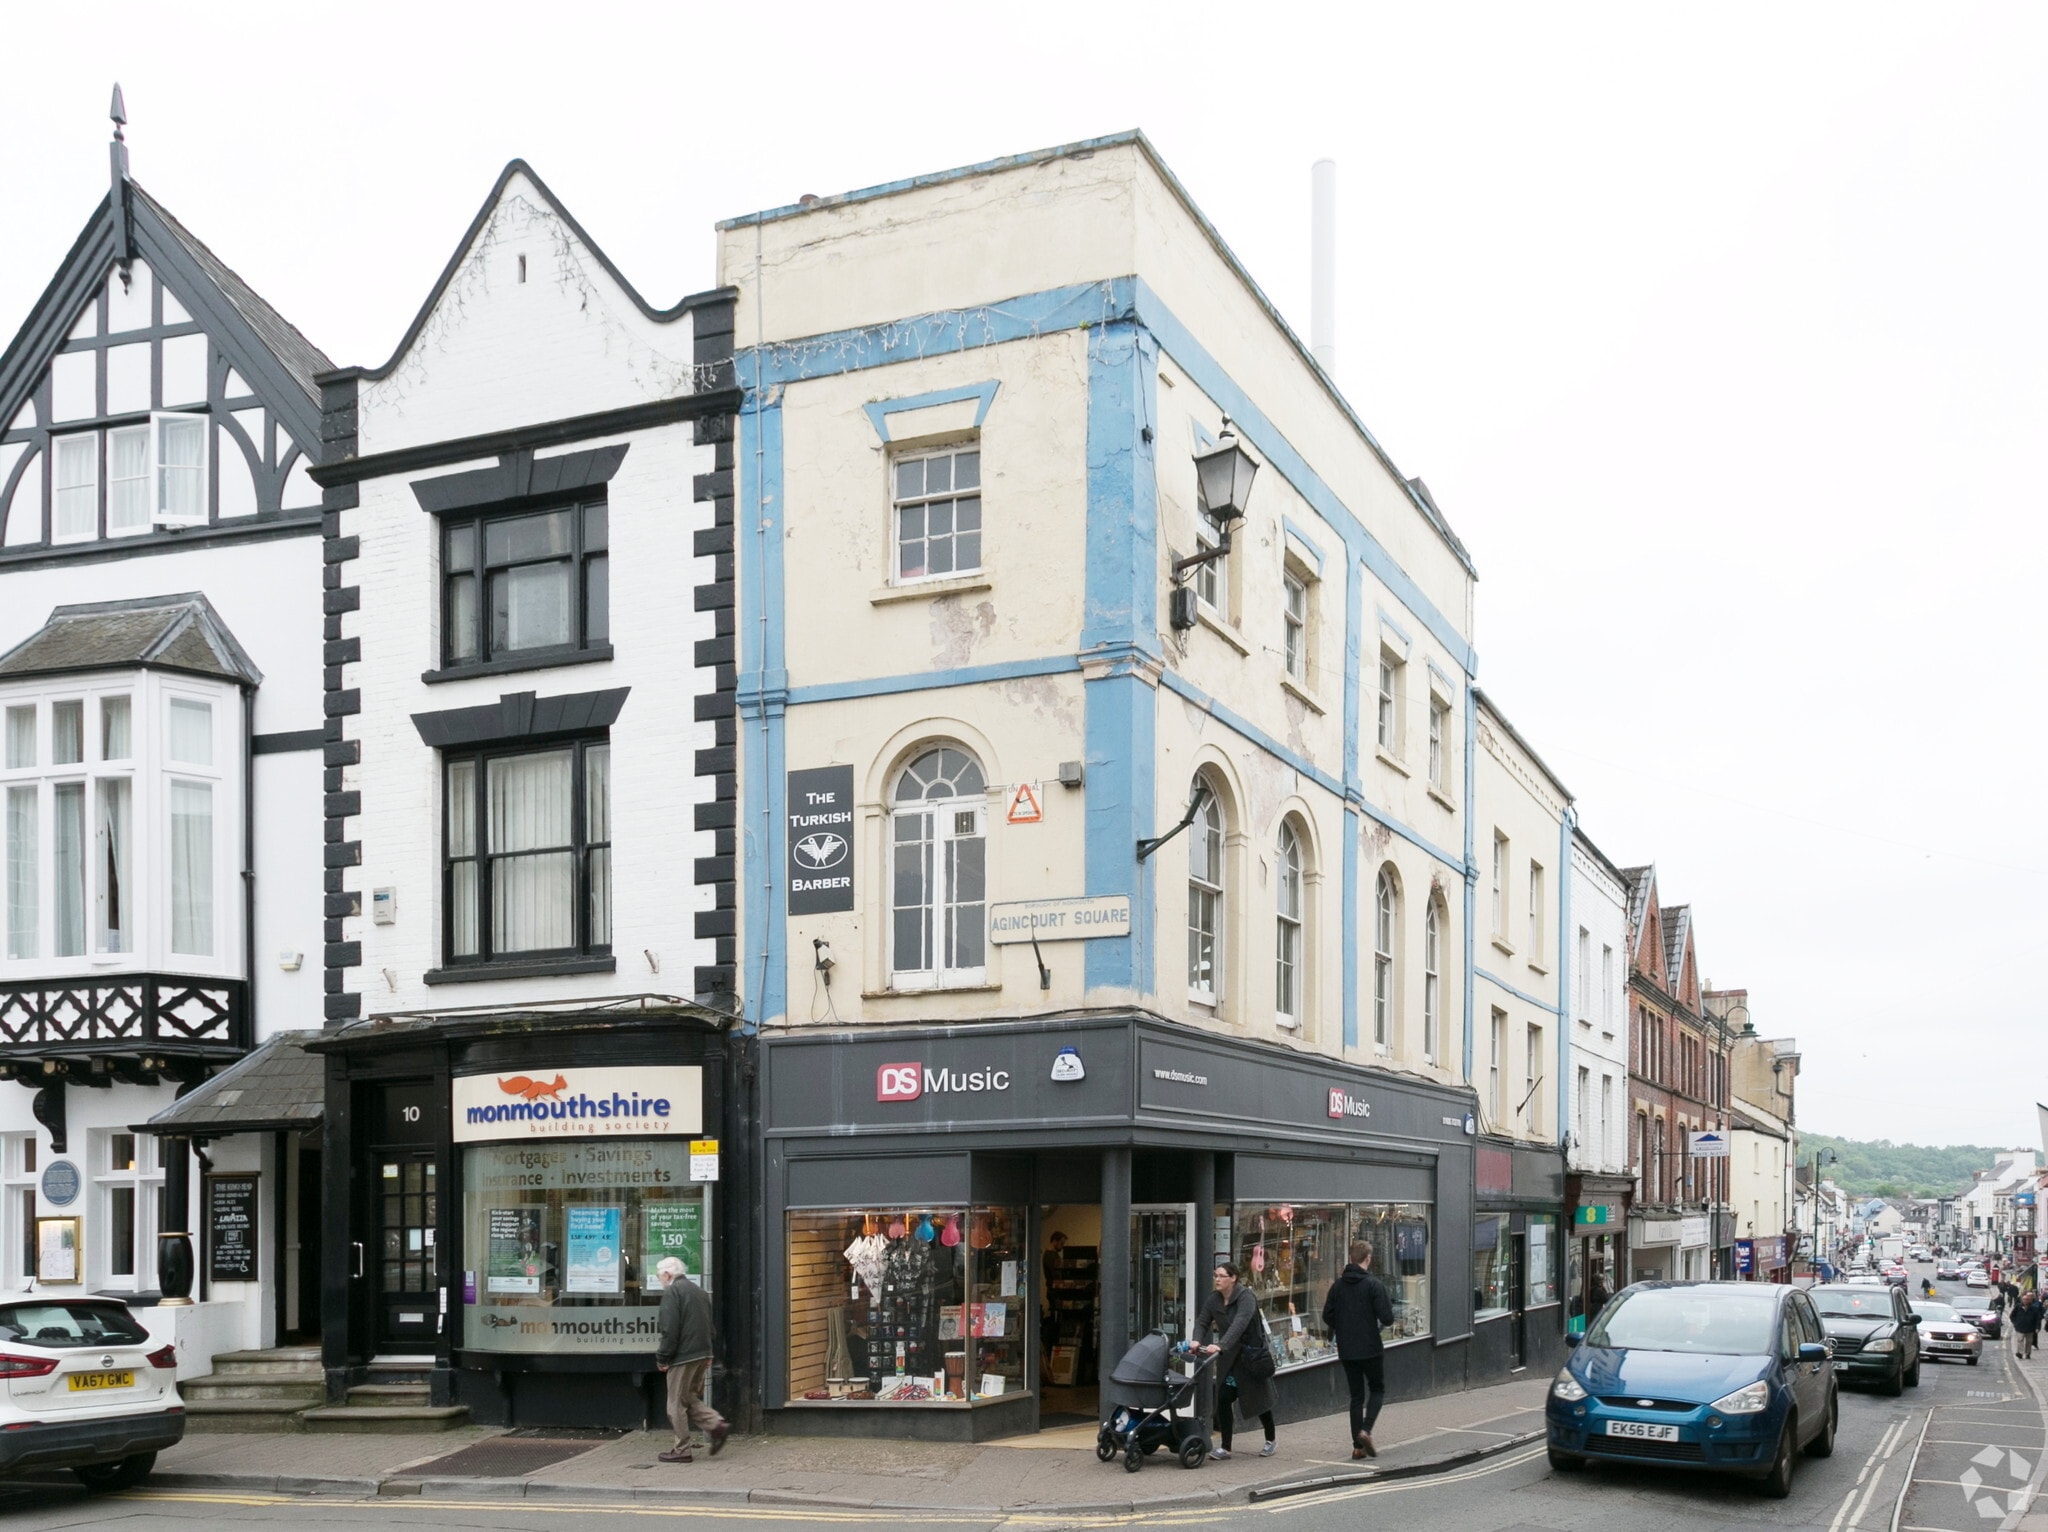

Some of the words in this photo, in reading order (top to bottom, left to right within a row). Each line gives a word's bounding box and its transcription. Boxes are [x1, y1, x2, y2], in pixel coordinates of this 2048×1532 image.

[806, 792, 835, 805] THE
[790, 812, 852, 827] TURKISH
[792, 877, 851, 891] BARBER
[992, 912, 1066, 931] AGINCOURT
[1073, 908, 1128, 925] SQUARE
[881, 1067, 917, 1095] DS
[923, 1066, 1010, 1093] Music
[1154, 1069, 1208, 1086] www.dsmusic.com
[466, 1091, 671, 1124] monmouthshire
[1330, 1091, 1343, 1114] DS
[1344, 1095, 1370, 1118] Music
[402, 1106, 420, 1122] 10
[531, 1122, 594, 1133] building
[605, 1119, 669, 1131] society
[492, 1149, 567, 1169] Mortgages
[586, 1146, 653, 1168] Savings
[482, 1171, 543, 1187] Insurance
[562, 1168, 671, 1186] Investments
[520, 1316, 662, 1335] monmouthshi
[576, 1336, 624, 1345] building
[73, 1374, 105, 1388] VA67
[107, 1373, 129, 1386] GWC
[1612, 1422, 1645, 1436] EK56
[1648, 1425, 1673, 1439] EJF
